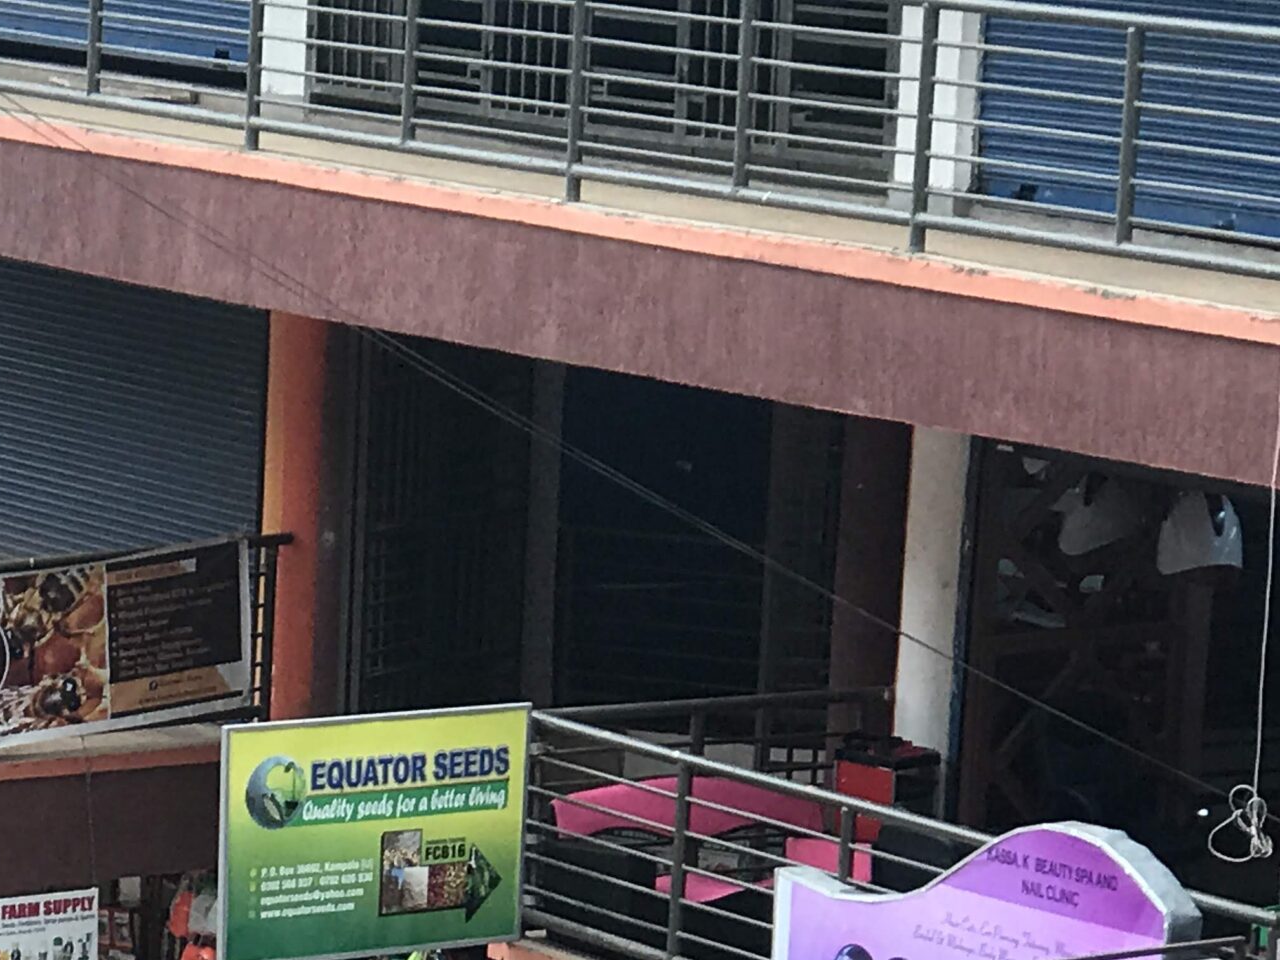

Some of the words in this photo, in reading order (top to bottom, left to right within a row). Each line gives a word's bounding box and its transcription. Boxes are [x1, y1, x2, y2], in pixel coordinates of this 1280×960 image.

[310, 753, 428, 792] EQUATOR
[433, 746, 510, 781] SEEDS
[302, 795, 355, 823] Quality
[357, 796, 394, 819] seeds
[395, 792, 415, 818] for
[418, 798, 428, 811] a
[430, 788, 466, 811] better
[468, 784, 506, 810] living
[1034, 857, 1073, 881] BEAUTY
[1074, 865, 1095, 886] SPA
[1095, 871, 1119, 892] AND
[1, 901, 40, 921] FARM
[42, 896, 96, 917] SUPPLY
[1021, 879, 1045, 899] NAIL
[1045, 884, 1081, 908] CLINIC
